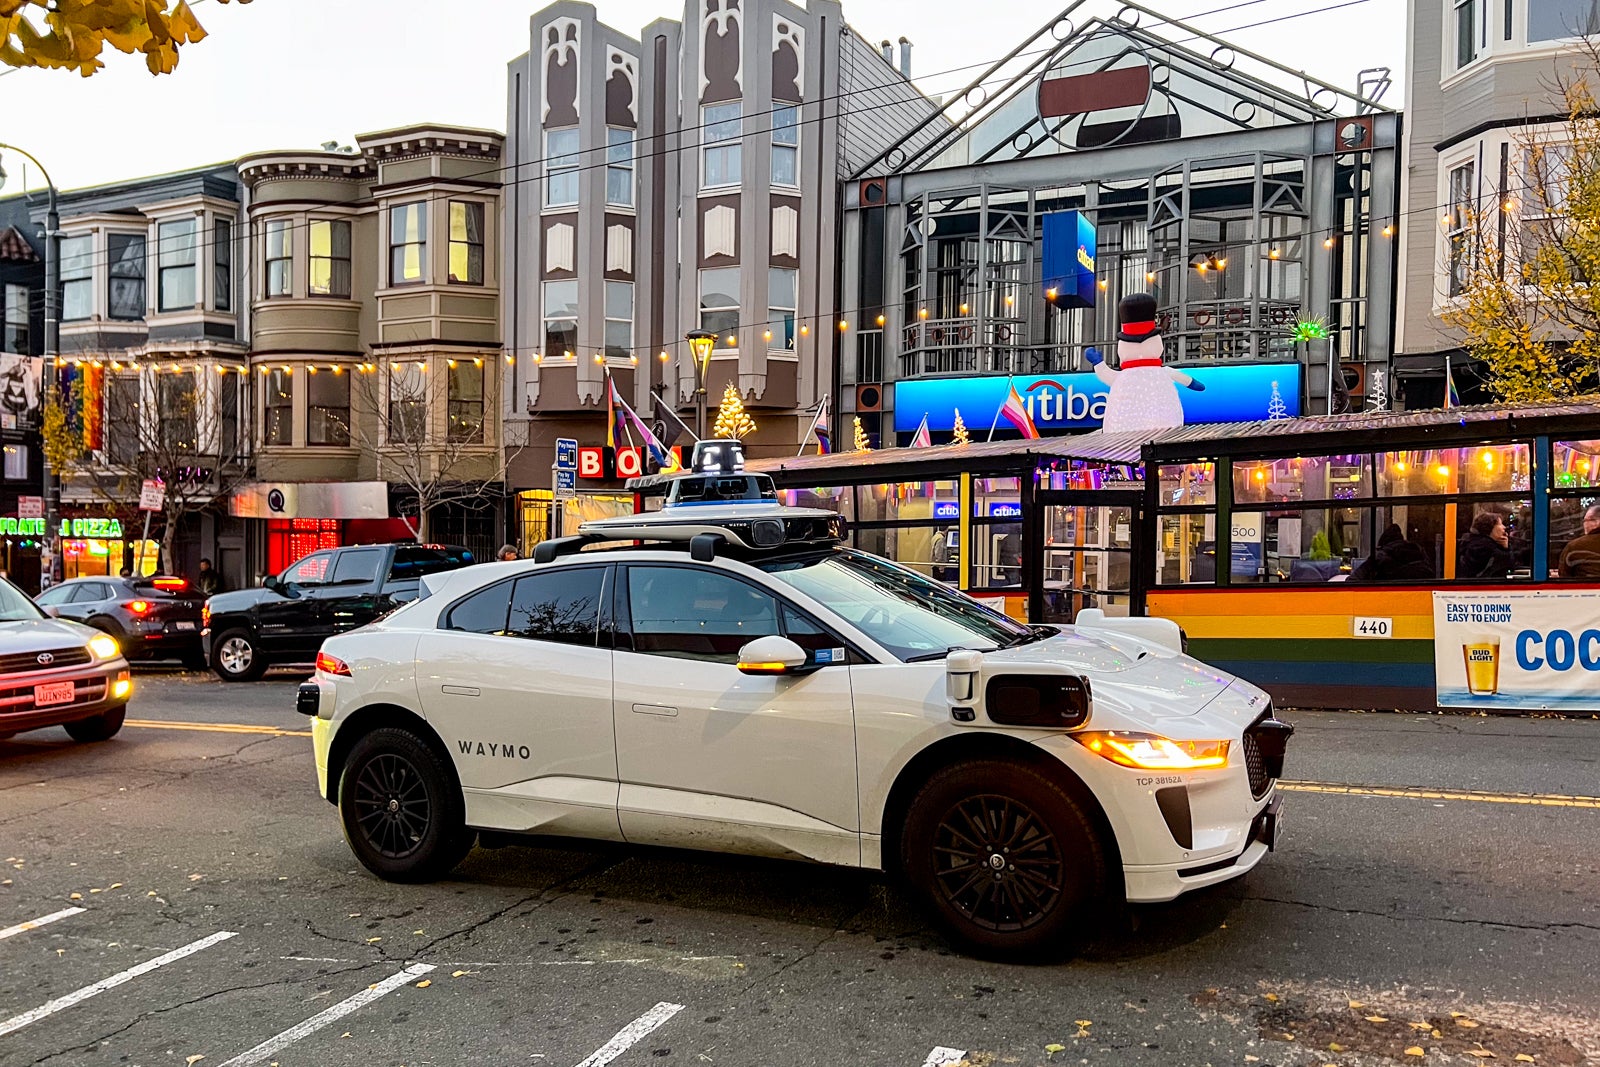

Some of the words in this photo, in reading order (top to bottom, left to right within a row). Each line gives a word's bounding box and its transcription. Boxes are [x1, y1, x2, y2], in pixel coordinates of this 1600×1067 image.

[1019, 381, 1110, 421] itiba
[268, 488, 285, 513] Q
[937, 505, 959, 516] citib
[993, 506, 1021, 517] citiba
[0, 518, 70, 537] FRATEI
[73, 518, 122, 537] PIZZA
[1232, 528, 1256, 537] 500
[1447, 604, 1469, 613] EASY
[1470, 604, 1482, 613] TO
[1484, 604, 1512, 613] DRINK
[1447, 614, 1469, 622] EASY
[1470, 614, 1483, 622] TO
[1484, 614, 1512, 623] ENJOY
[1359, 620, 1388, 635] 440
[1515, 629, 1600, 672] COC
[458, 740, 530, 760] WAYMO
[1136, 777, 1153, 786] TCP
